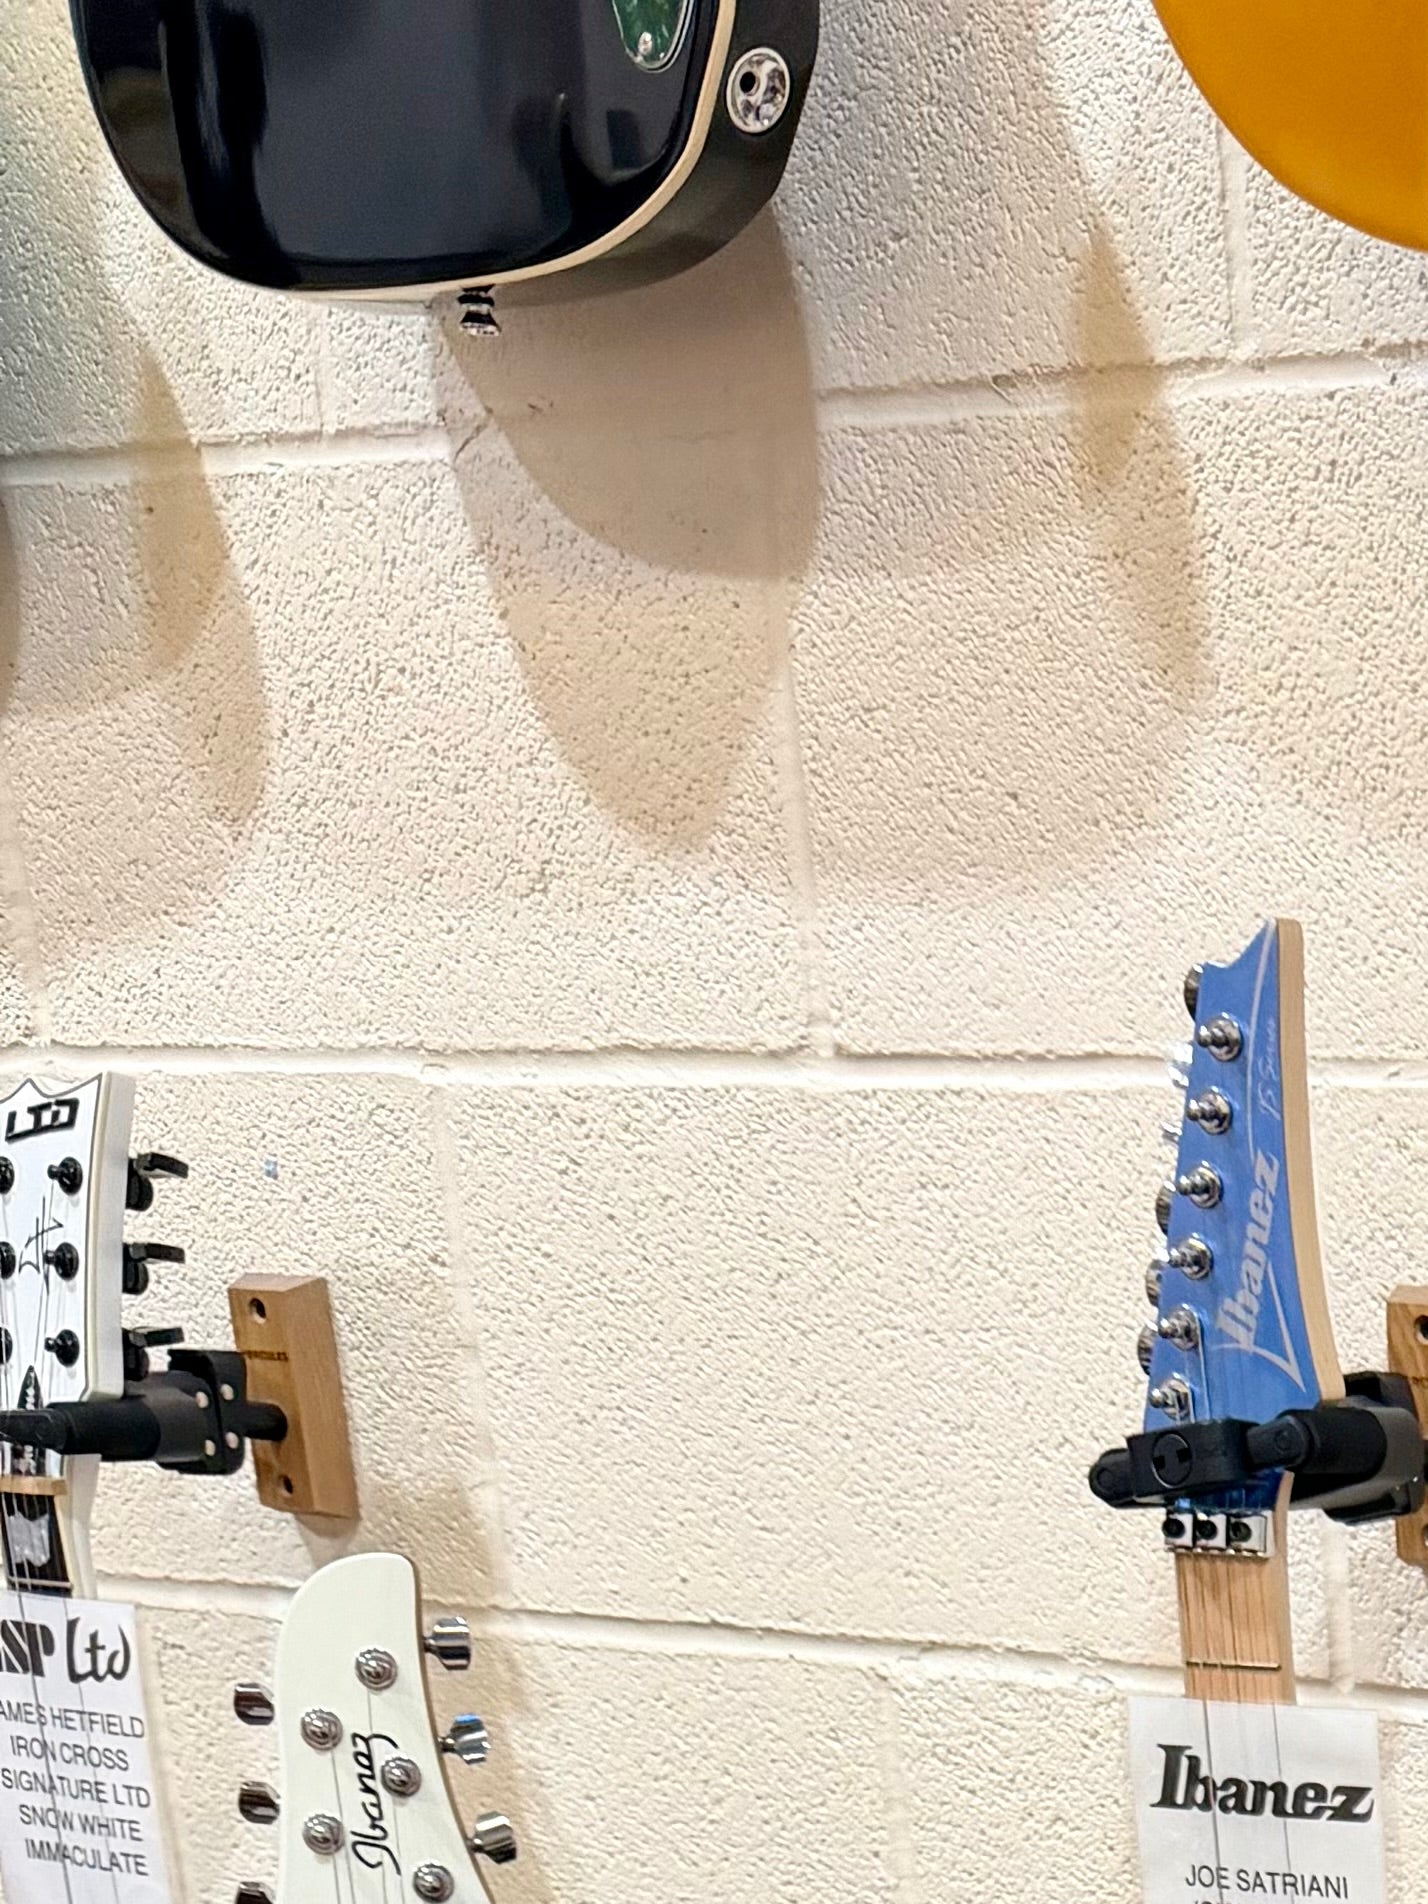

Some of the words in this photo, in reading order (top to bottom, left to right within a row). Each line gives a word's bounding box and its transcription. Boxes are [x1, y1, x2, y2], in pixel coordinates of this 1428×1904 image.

[5, 1099, 79, 1142] LTD
[1213, 1149, 1280, 1350] Ibanez
[0, 1618, 55, 1677] SP
[65, 1616, 131, 1684] Ltd
[50, 1706, 145, 1739] HETFIELD
[10, 1734, 57, 1763] IRON
[60, 1742, 129, 1772] CROSS
[1, 1768, 107, 1801] SIGNATURE
[113, 1783, 151, 1808] LTD
[1149, 1743, 1375, 1824] Ibanez
[19, 1804, 76, 1833] SNOW
[78, 1812, 143, 1842] WHITE
[351, 1733, 401, 1876] Ibanez
[25, 1838, 149, 1877] IMMACULATE
[1185, 1864, 1230, 1890] JOE
[1236, 1868, 1349, 1900] SATRIANI
